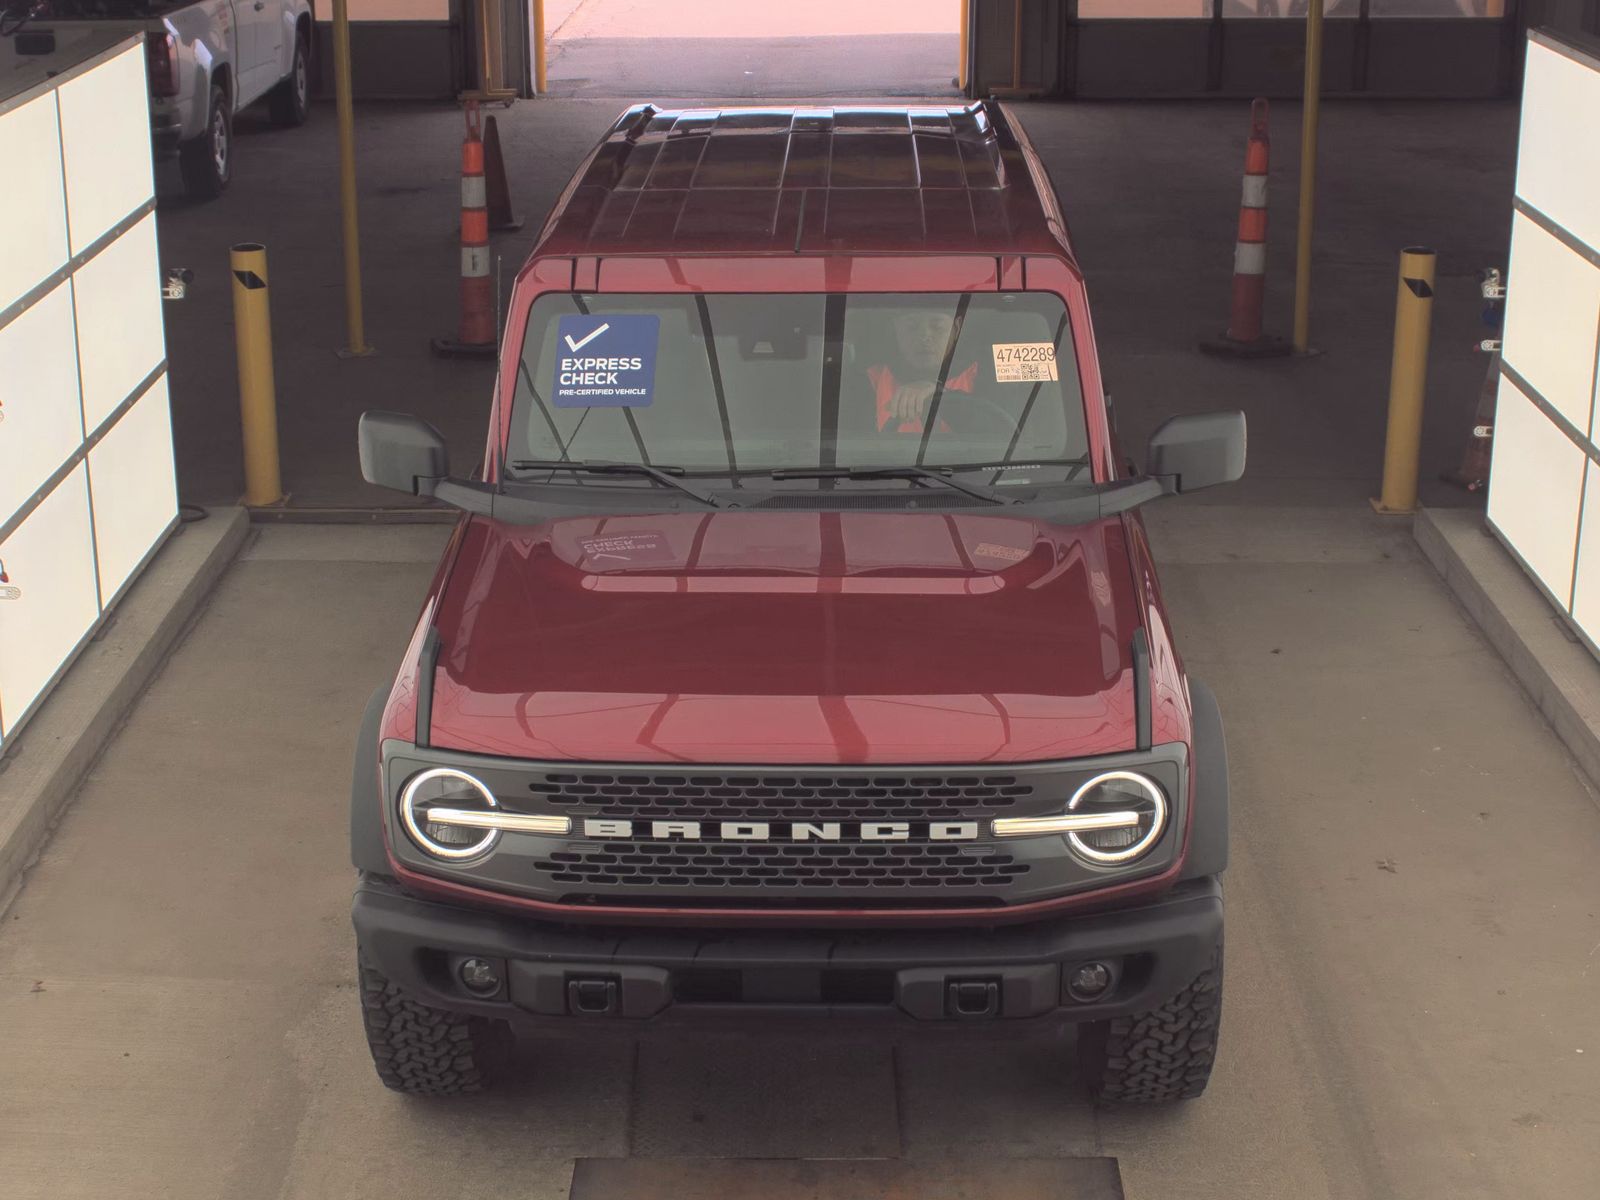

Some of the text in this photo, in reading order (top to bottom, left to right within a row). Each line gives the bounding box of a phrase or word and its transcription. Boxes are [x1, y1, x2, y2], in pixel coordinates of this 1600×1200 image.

[997, 347, 1055, 362] 4742289
[561, 357, 642, 371] EXPRESS
[559, 372, 618, 385] CHECK
[584, 818, 978, 840] BRONCO
